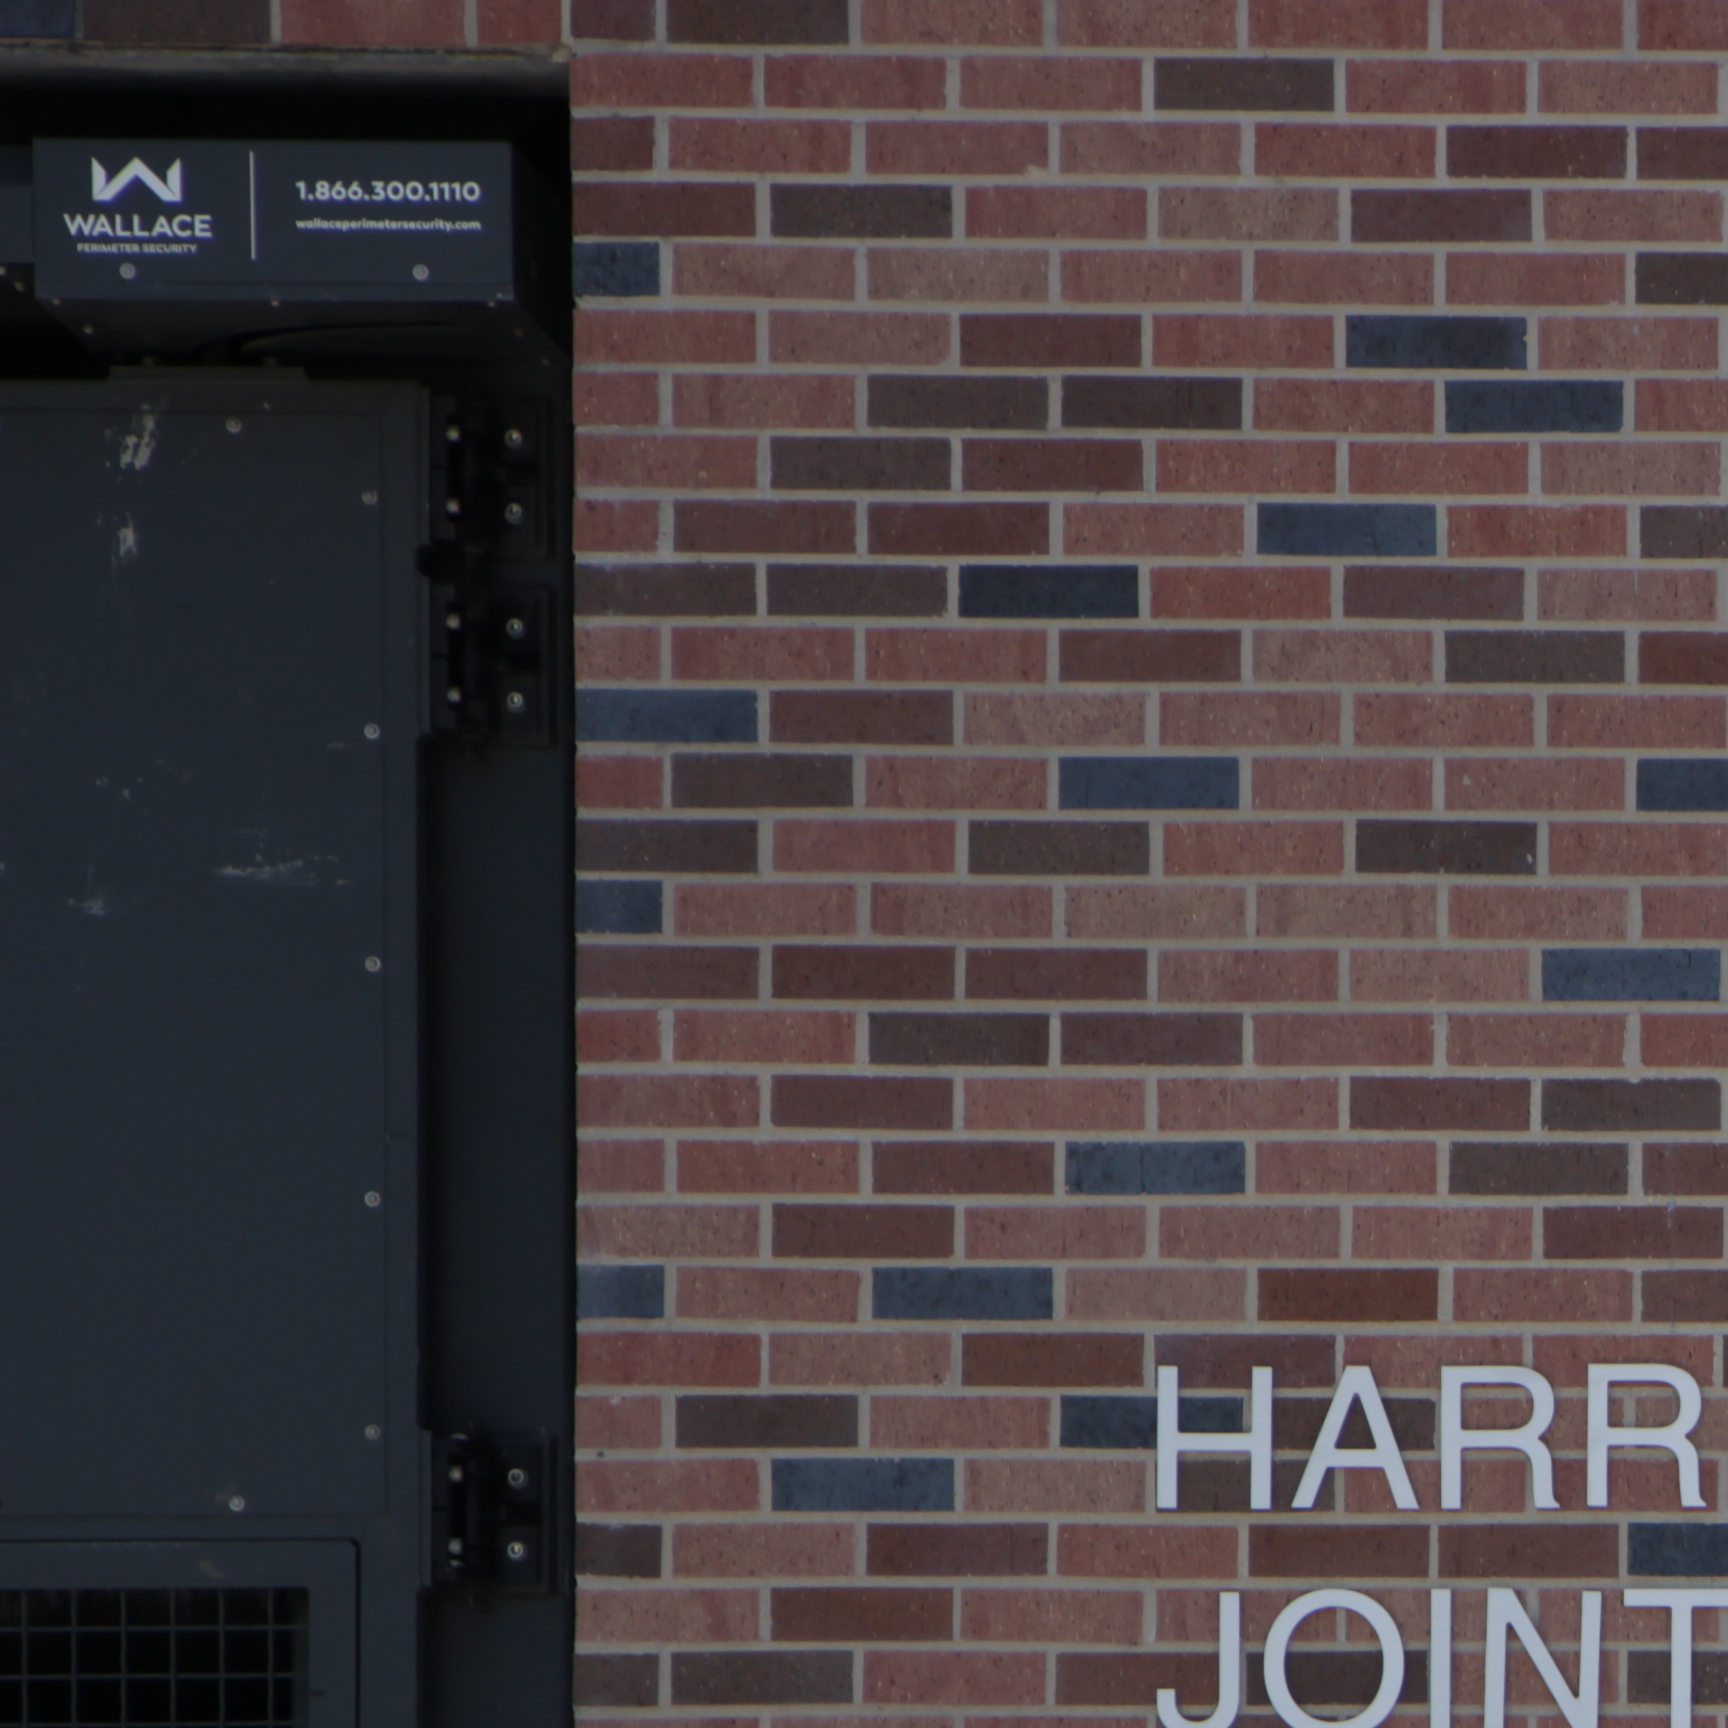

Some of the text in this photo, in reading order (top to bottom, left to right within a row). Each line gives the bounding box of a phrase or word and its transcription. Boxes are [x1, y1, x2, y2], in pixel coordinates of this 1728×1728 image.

[295, 180, 482, 202] 1.866.300.1110
[63, 213, 213, 238] WALLACE
[295, 217, 482, 232] wallaceperimetersecurity.com
[76, 242, 198, 254] PERIMETER SECURITY
